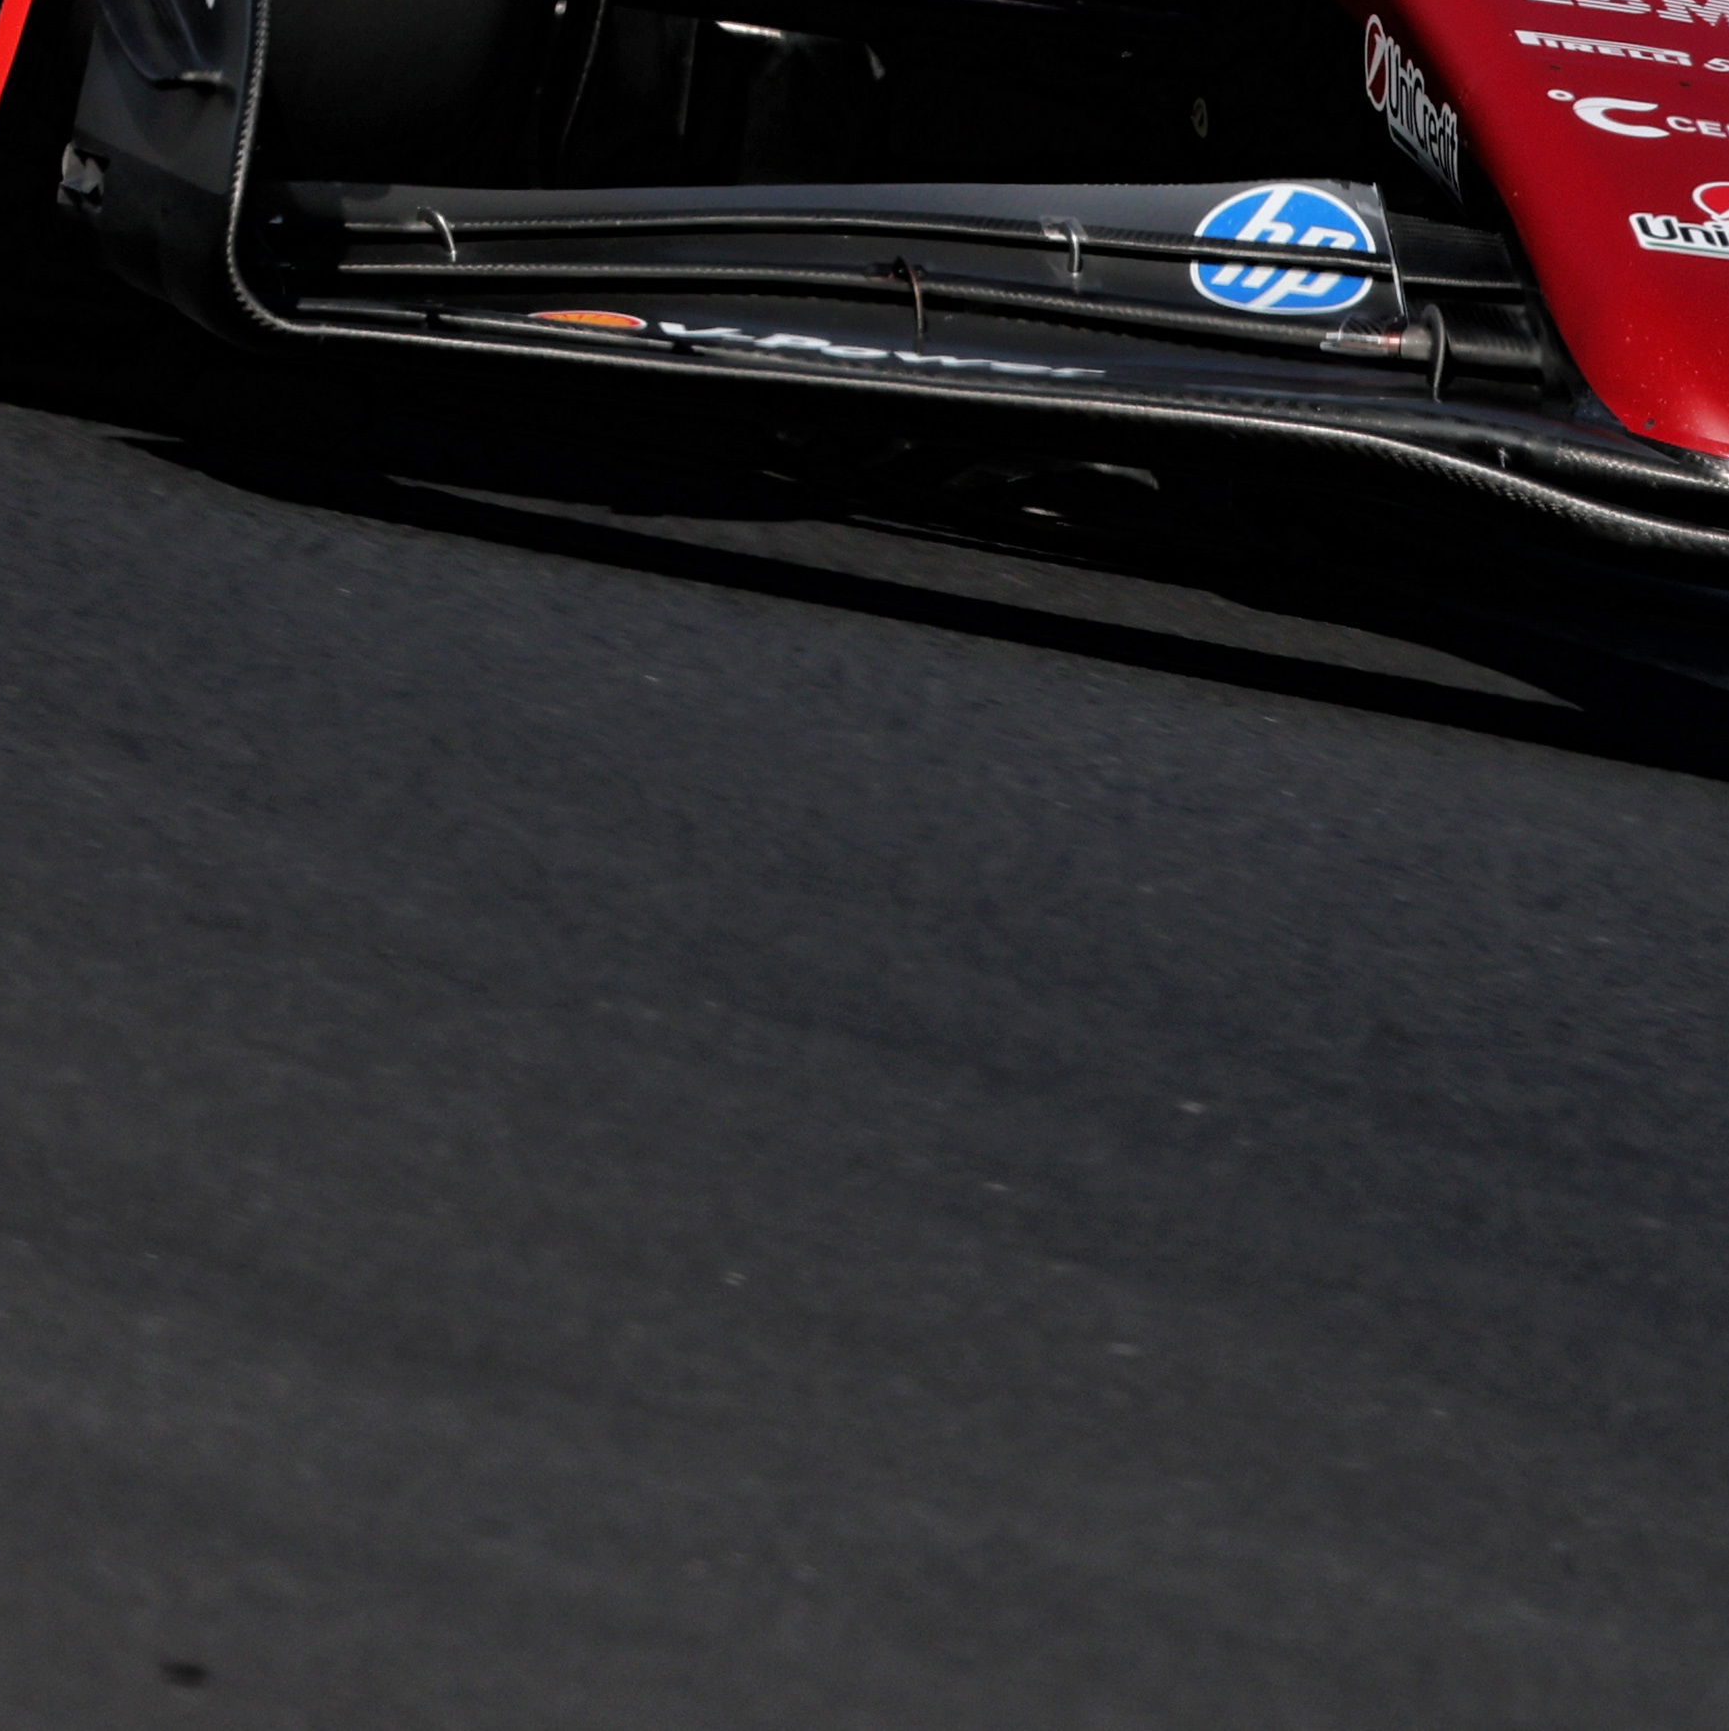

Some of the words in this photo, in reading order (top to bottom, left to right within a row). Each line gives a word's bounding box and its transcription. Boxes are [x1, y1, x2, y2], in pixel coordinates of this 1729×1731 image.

[1514, 29, 1693, 67] PIRELLI
[1387, 43, 1460, 192] UniCredit
[1210, 186, 1357, 310] hp
